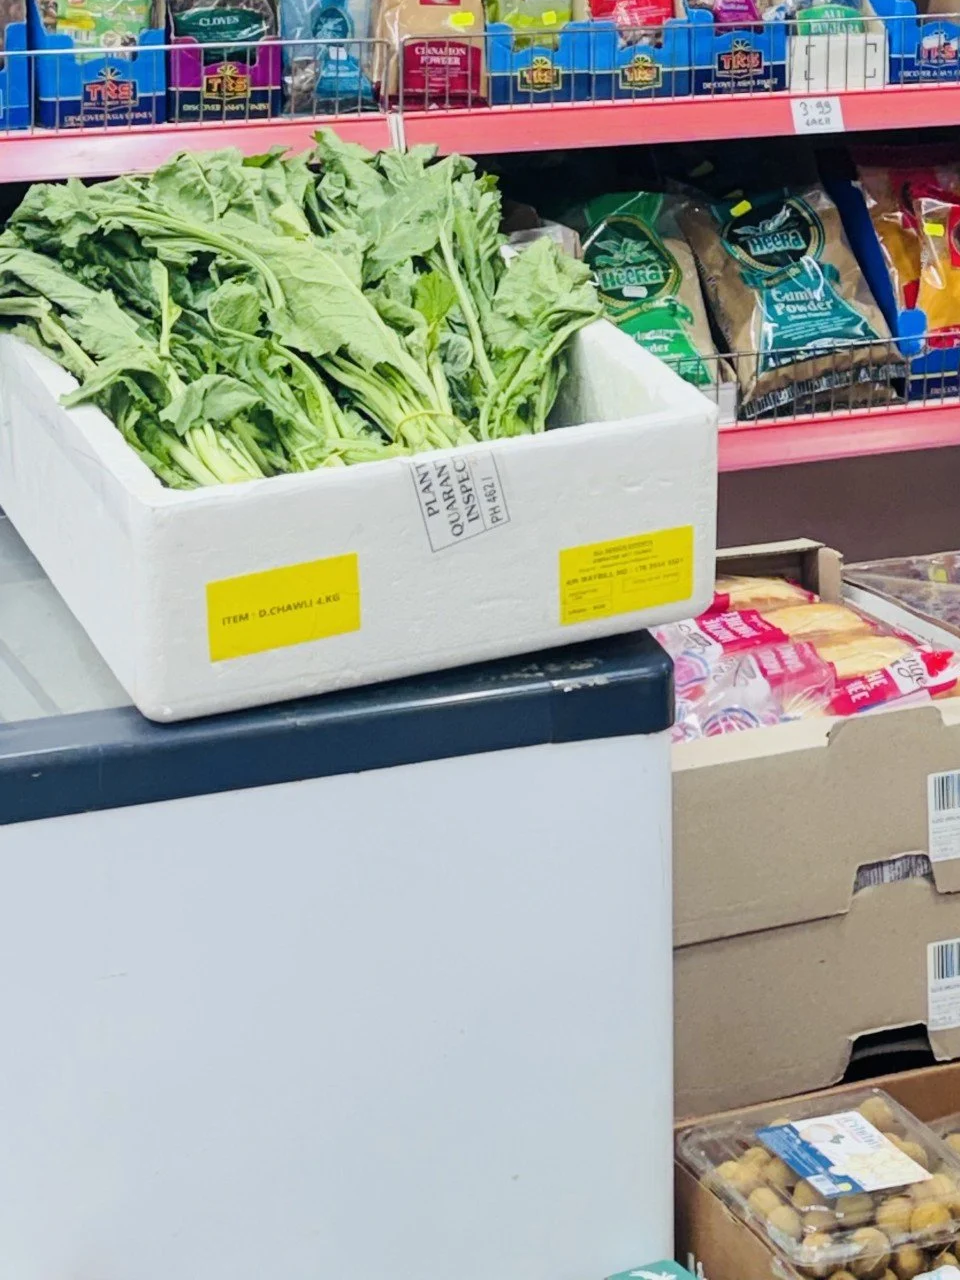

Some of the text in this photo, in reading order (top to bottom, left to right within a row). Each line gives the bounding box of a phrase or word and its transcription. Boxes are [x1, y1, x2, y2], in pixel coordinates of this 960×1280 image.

[194, 15, 240, 28] CLOVES
[721, 53, 760, 70] TRS
[86, 82, 134, 101] TRS
[207, 76, 249, 93] TRS
[774, 297, 834, 316] Powder
[450, 455, 482, 523] INSPEC
[434, 461, 464, 539] QUARAN
[488, 504, 503, 525] PH
[222, 612, 249, 626] ITEM
